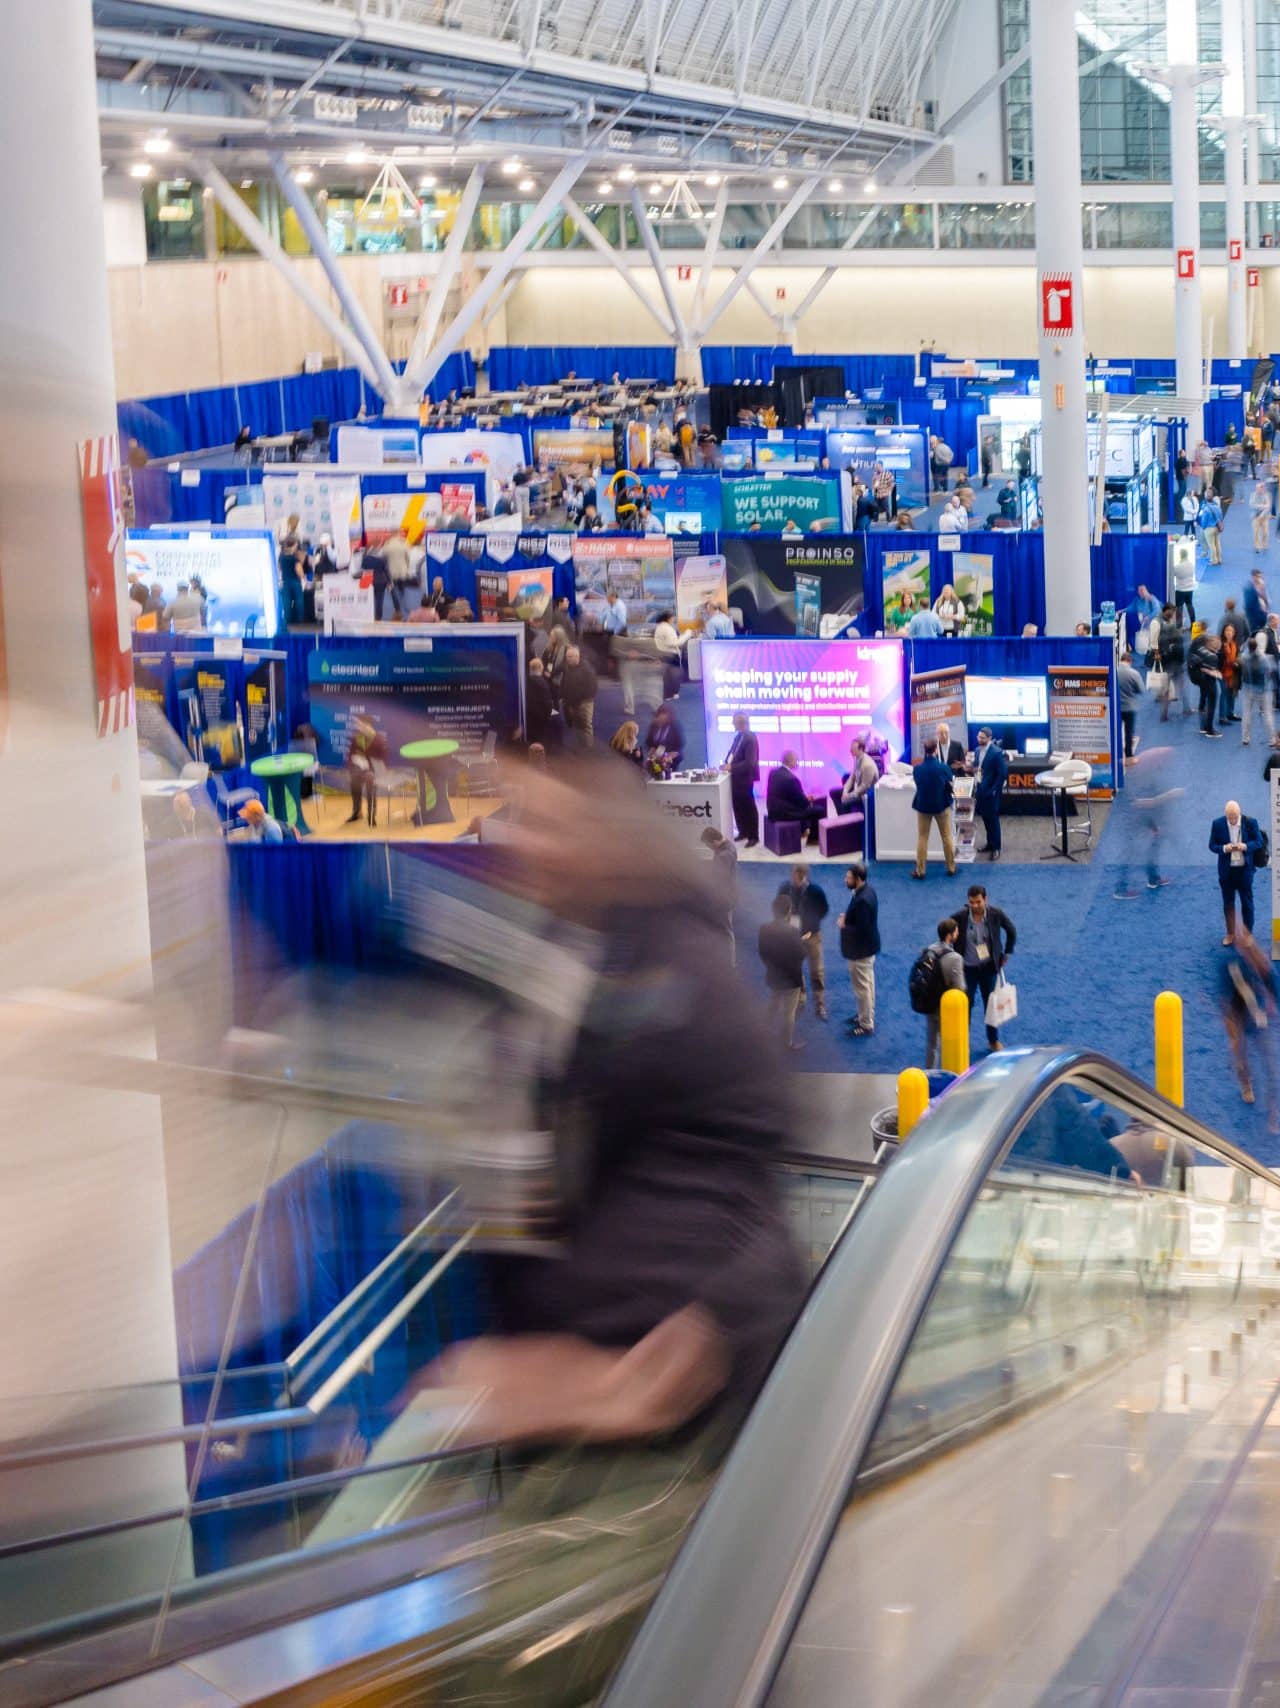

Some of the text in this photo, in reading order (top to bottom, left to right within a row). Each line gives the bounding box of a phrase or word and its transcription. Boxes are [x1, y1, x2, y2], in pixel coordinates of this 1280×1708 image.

[735, 496, 819, 510] WE SUPPORT
[331, 663, 379, 677] cleanleaf
[713, 668, 859, 685] Keeping your supply
[714, 684, 871, 702] chain moving forward
